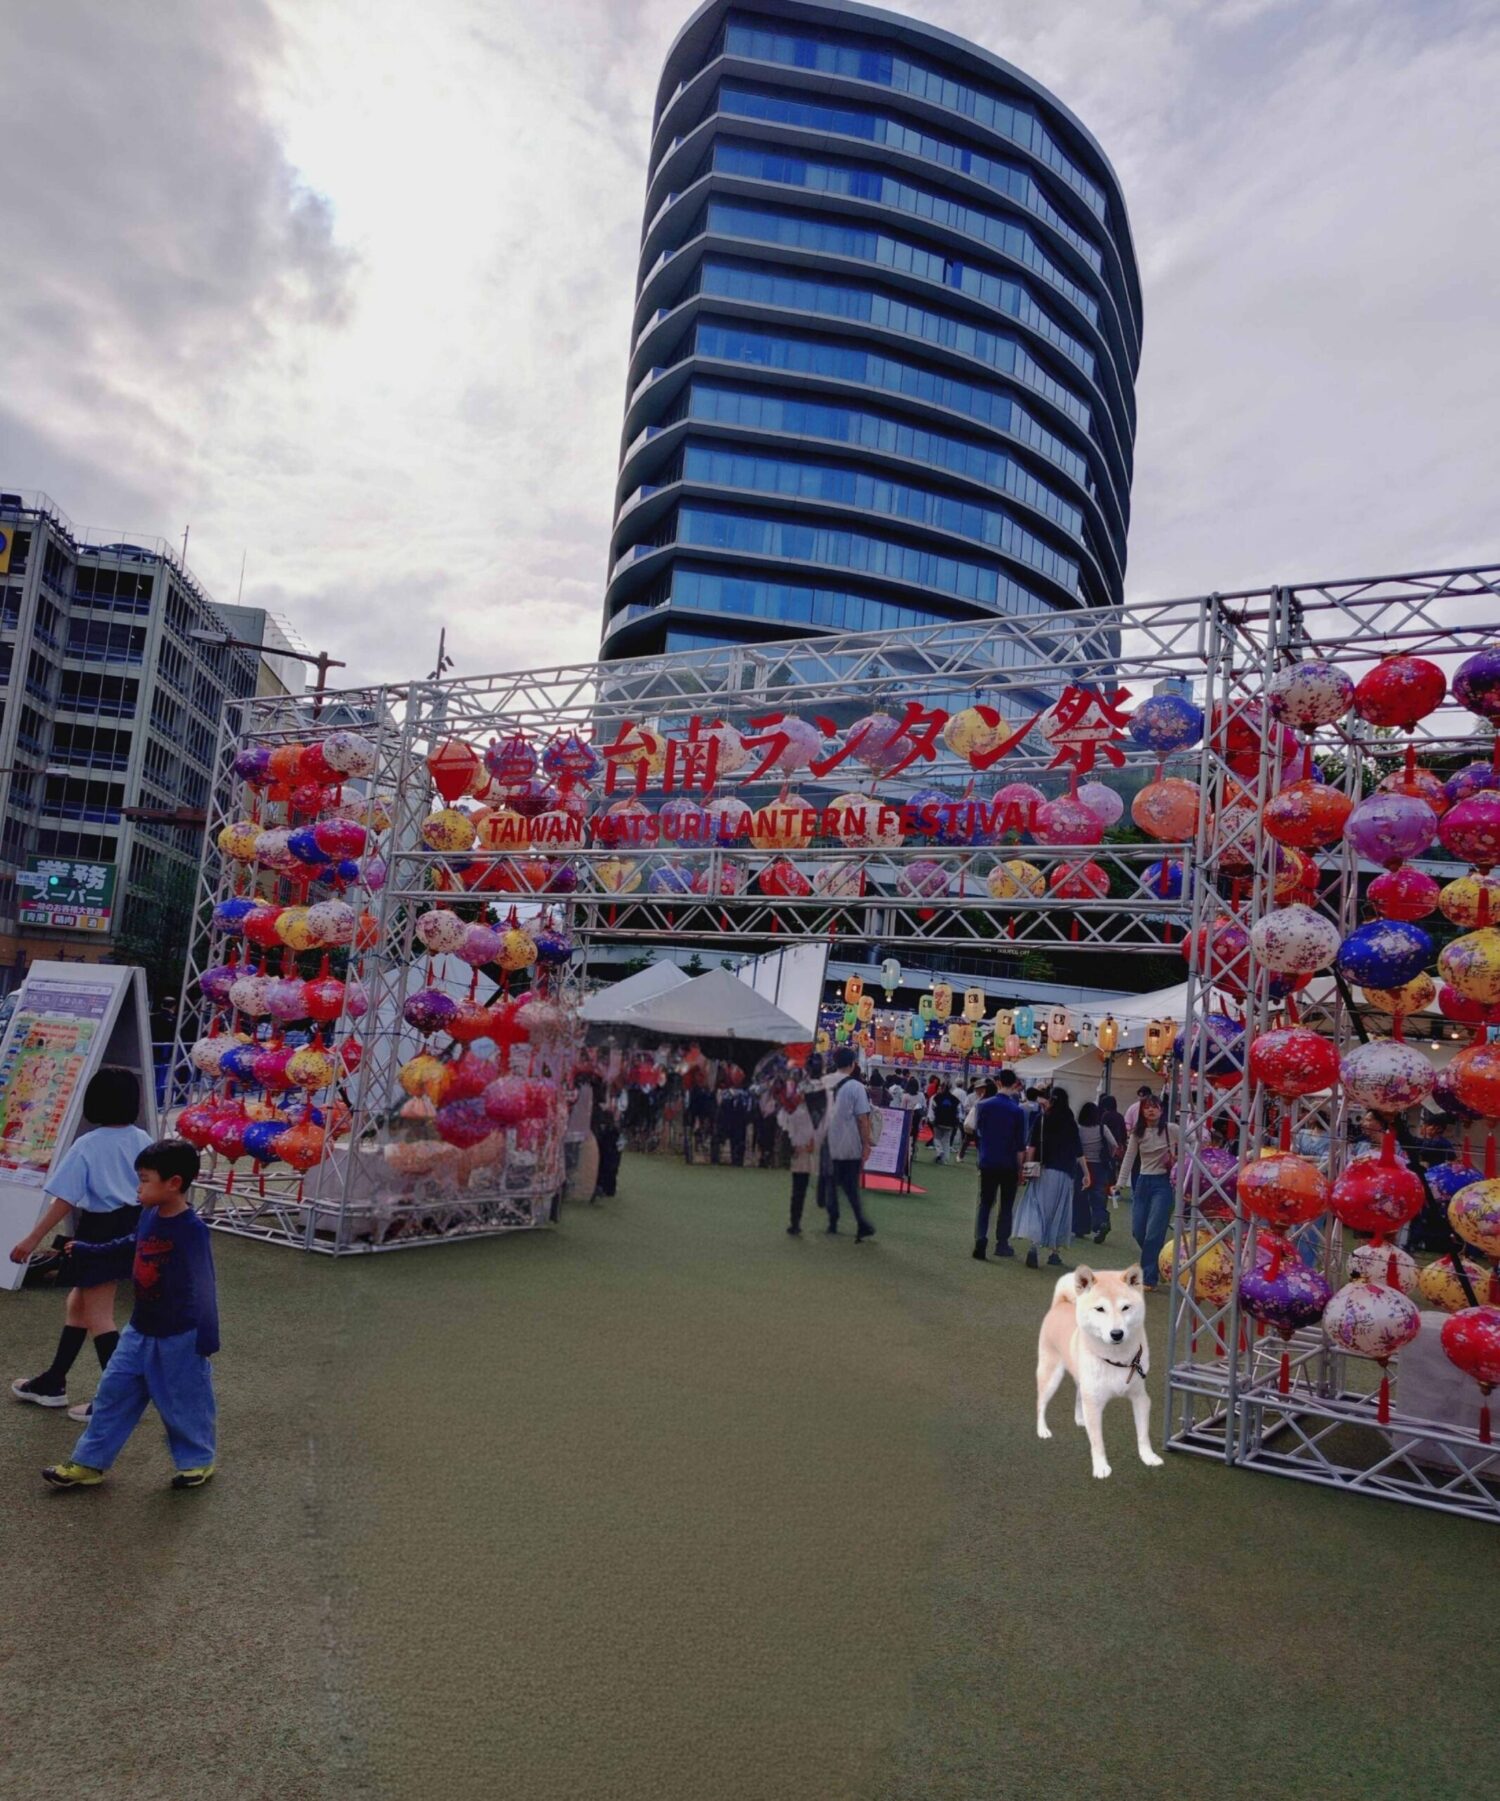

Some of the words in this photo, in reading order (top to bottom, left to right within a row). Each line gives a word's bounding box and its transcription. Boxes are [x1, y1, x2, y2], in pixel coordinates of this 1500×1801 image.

[603, 686, 1135, 796] 台南ランタン祭
[489, 816, 583, 843] TAIWAN
[591, 812, 711, 841] MATSURI
[720, 807, 866, 840] LANTERN
[877, 801, 1048, 836] FESTIVAL
[32, 886, 103, 903] スーパー
